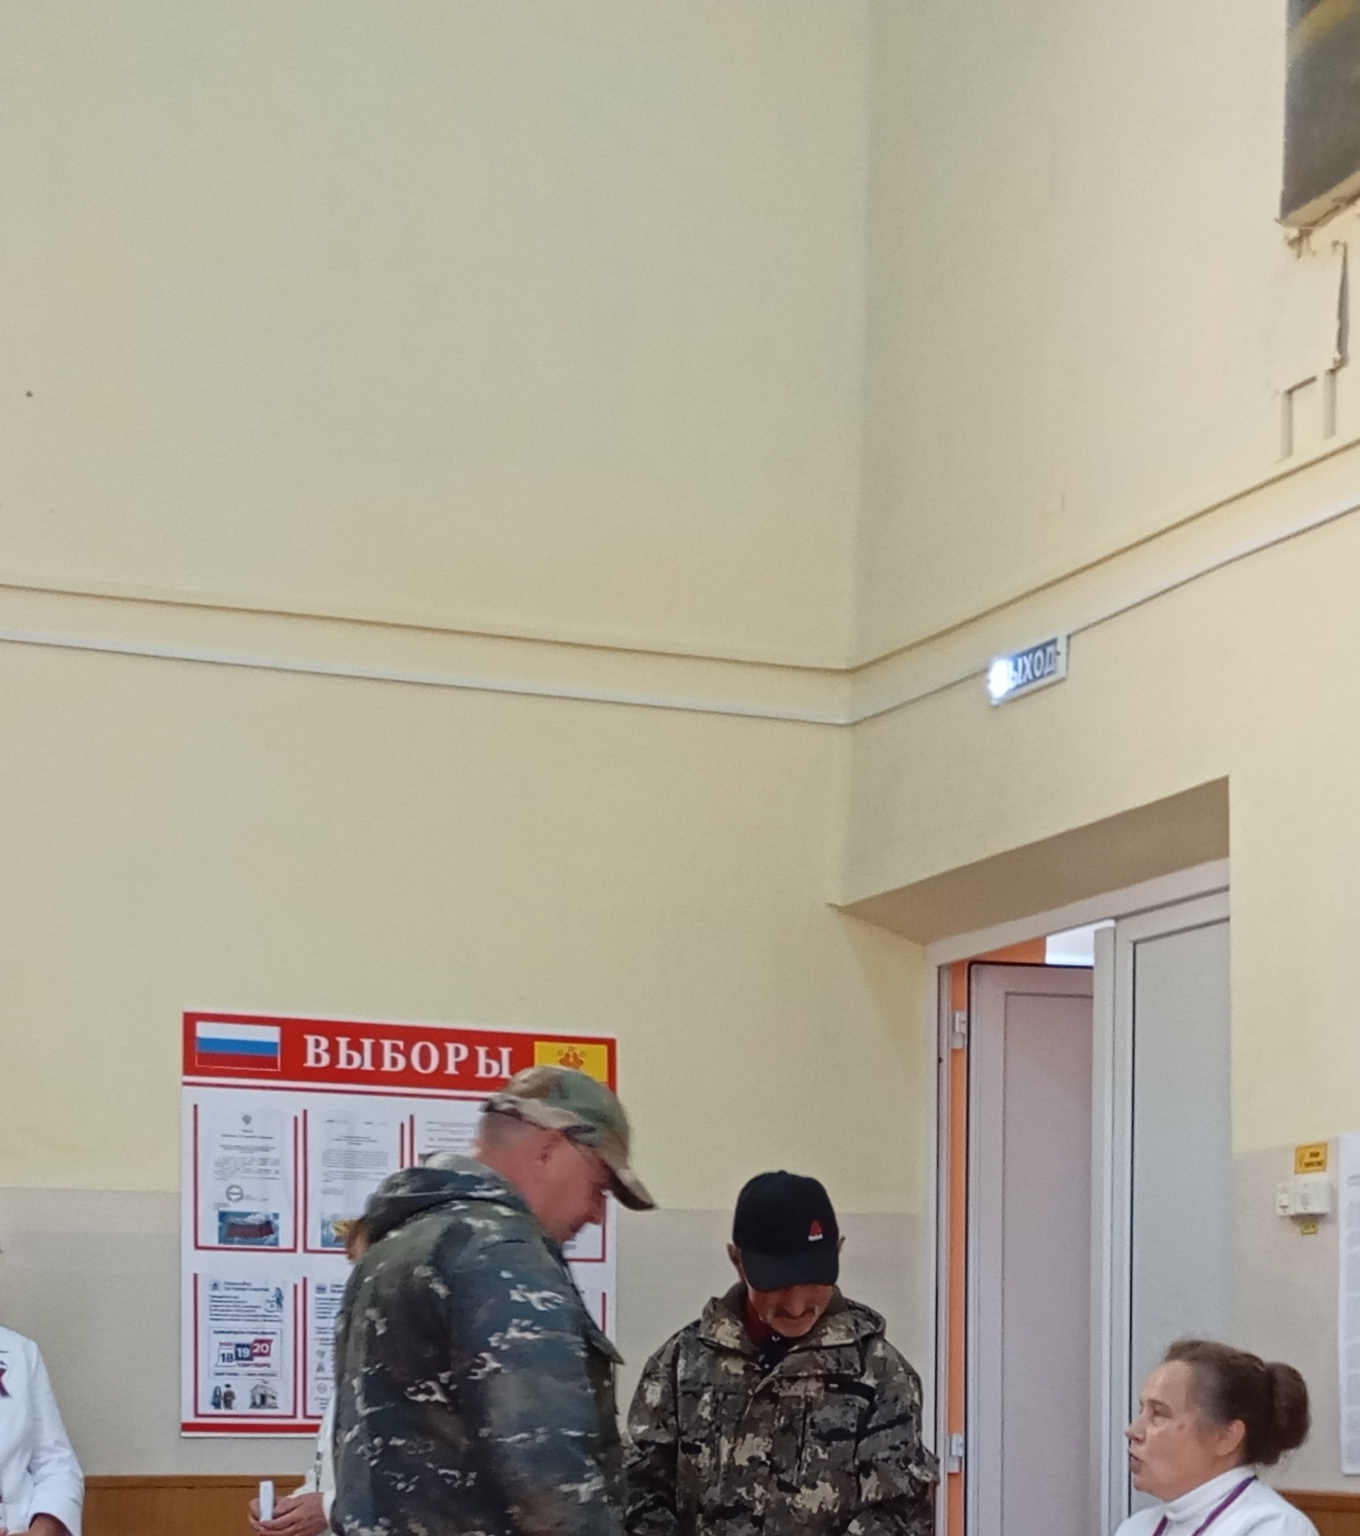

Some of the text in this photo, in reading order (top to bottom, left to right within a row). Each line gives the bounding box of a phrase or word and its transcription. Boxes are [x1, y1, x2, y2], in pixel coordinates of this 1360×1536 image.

[989, 643, 1057, 698] ЫХОД
[302, 1034, 513, 1080] ВЫБОРЫ
[236, 1346, 251, 1358] 19
[252, 1342, 270, 1354] 20
